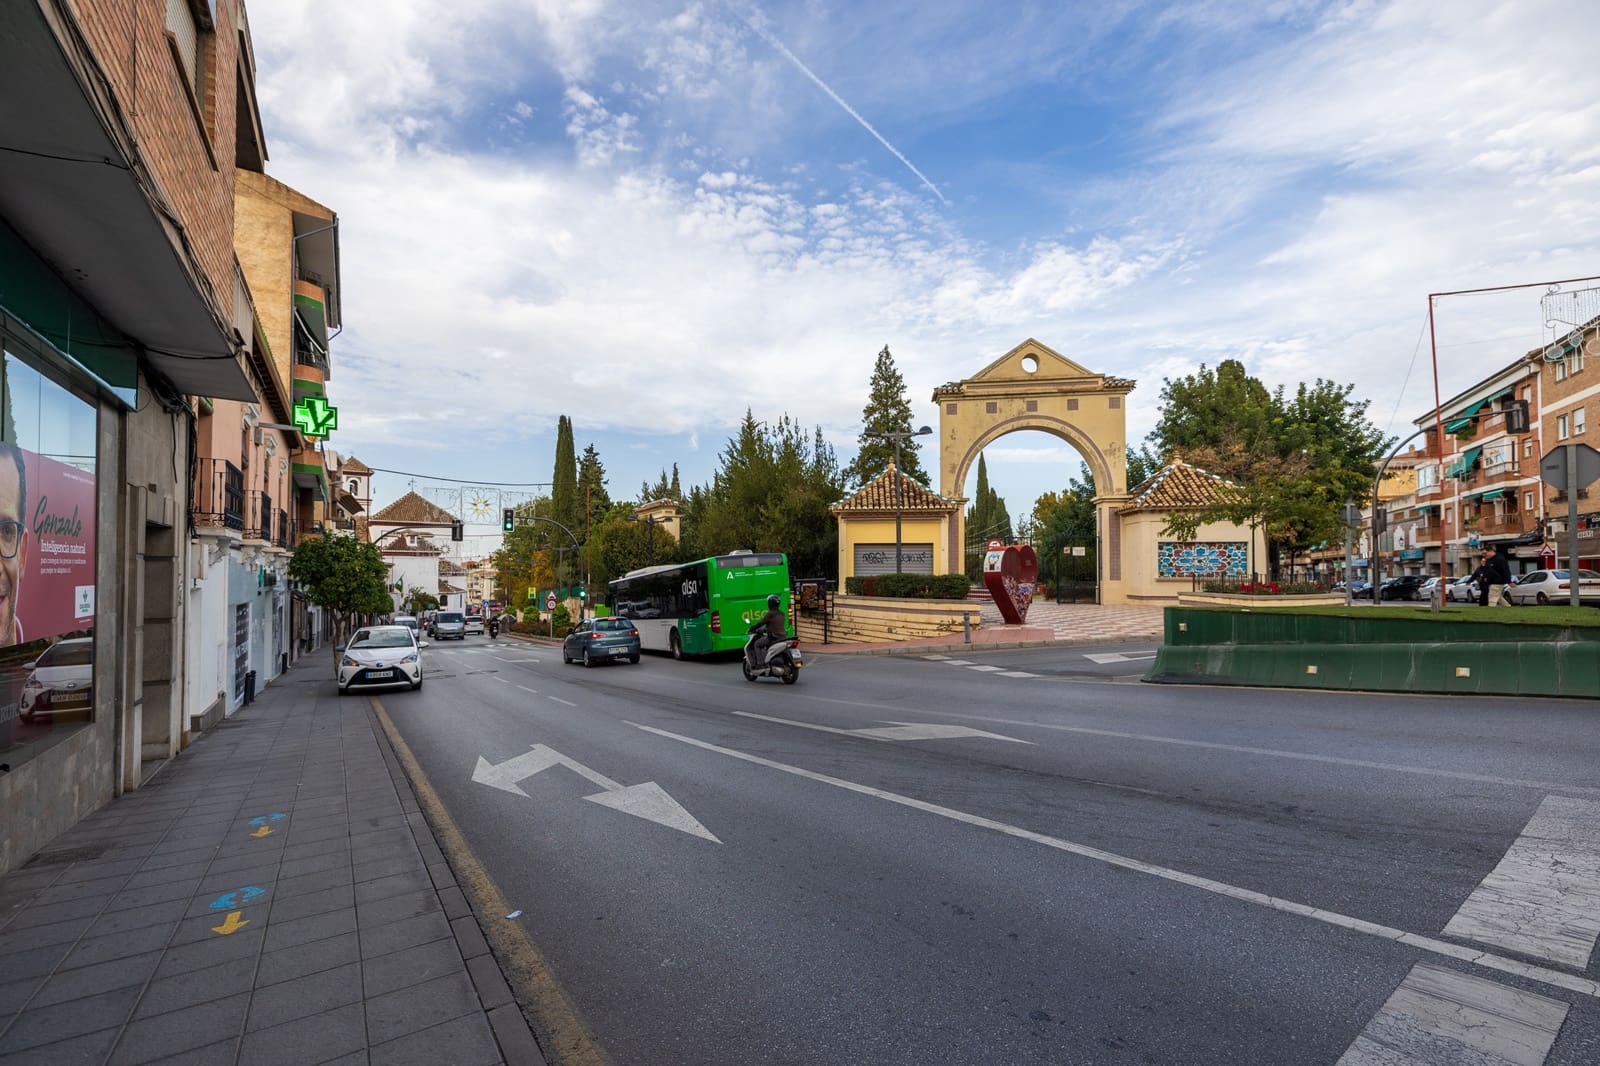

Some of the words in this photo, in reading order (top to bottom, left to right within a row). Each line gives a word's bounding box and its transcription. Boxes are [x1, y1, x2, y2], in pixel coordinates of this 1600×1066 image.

[33, 496, 82, 544] Gonzalo
[41, 540, 69, 555] Inteligencia
[70, 542, 86, 554] natural
[682, 578, 697, 595] alsa
